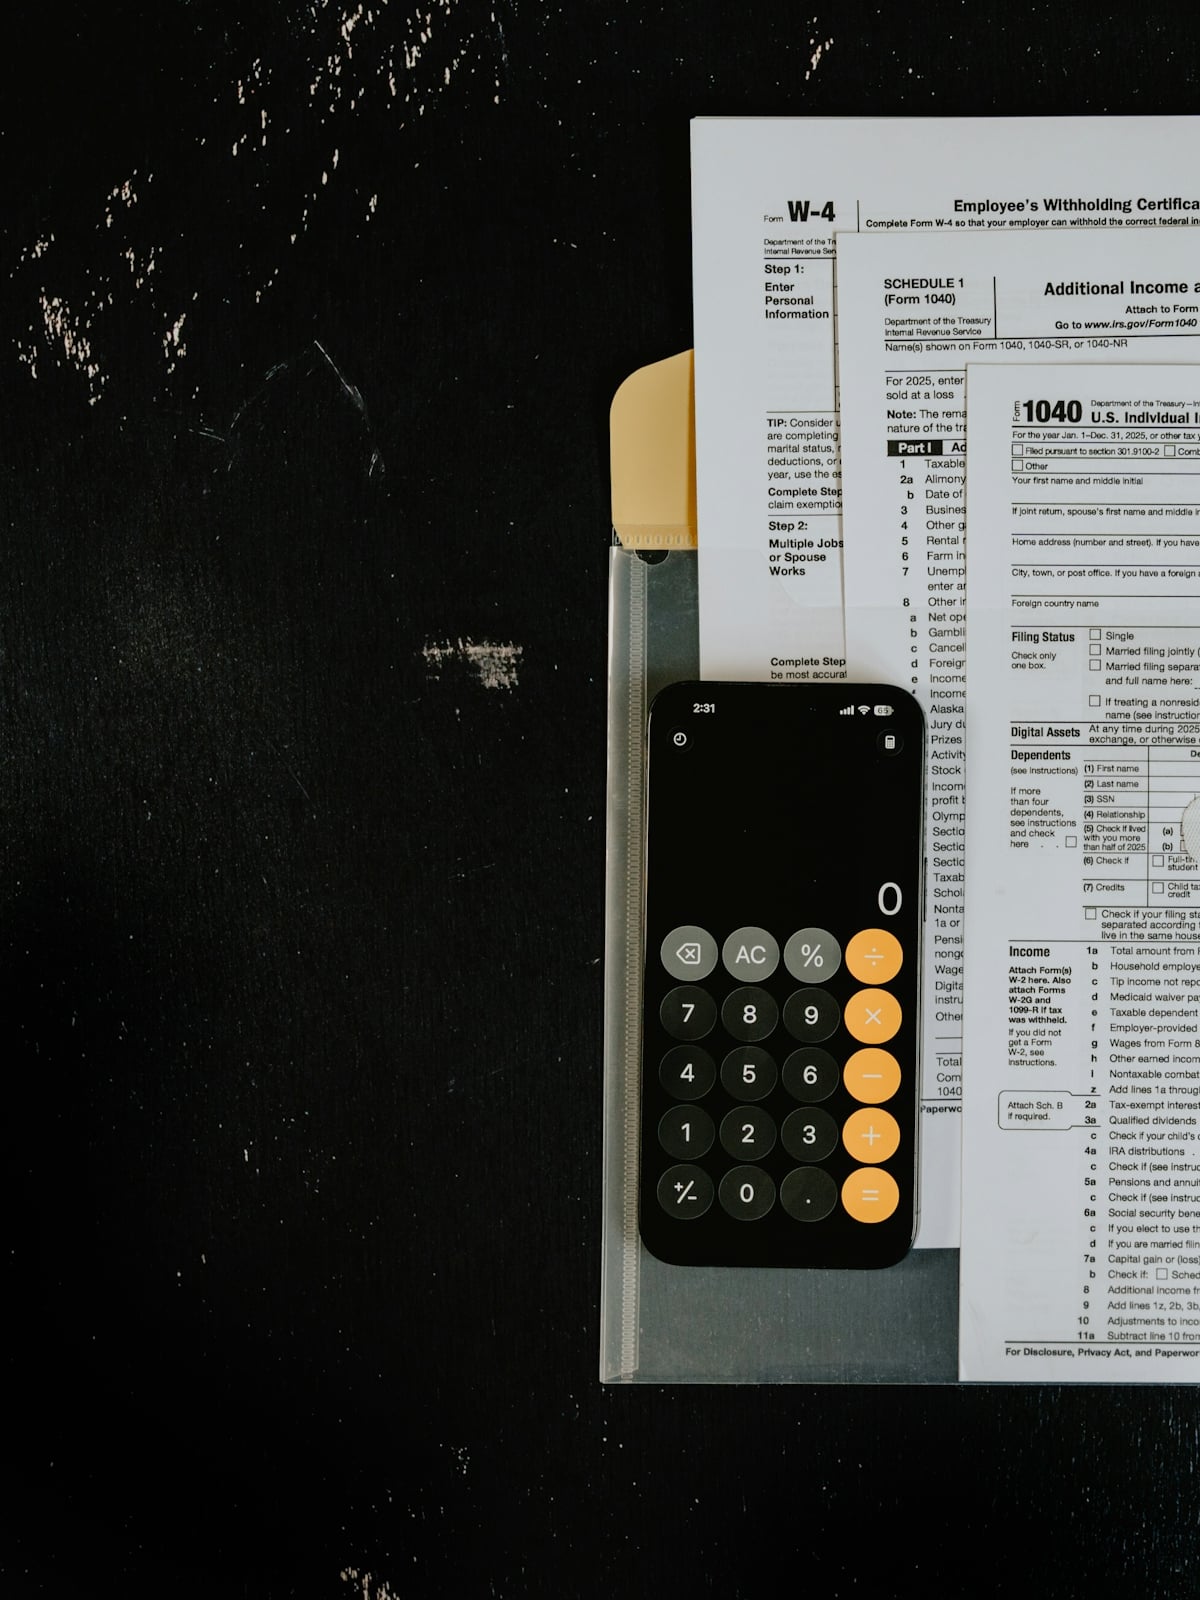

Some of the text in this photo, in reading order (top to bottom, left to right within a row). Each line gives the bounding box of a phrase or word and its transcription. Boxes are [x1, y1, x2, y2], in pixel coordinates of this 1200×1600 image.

[763, 200, 835, 223] Form W-4
[954, 198, 1038, 215] Employee's
[1043, 197, 1132, 213] Withholding
[764, 263, 804, 276] Step 1:
[764, 281, 794, 292] Enter
[884, 277, 954, 289] SCHEDULE
[1044, 280, 1124, 296] Additional
[1130, 280, 1188, 294] Income
[765, 295, 813, 305] Personal
[884, 292, 955, 306] (Form 1040)
[765, 308, 829, 319] Information
[1125, 304, 1157, 314] Attach
[1160, 305, 1170, 313] to
[1173, 304, 1198, 313] Form
[884, 316, 991, 327] Department of the Treasury
[1055, 320, 1069, 329] Go
[1071, 320, 1082, 329] to
[1084, 318, 1197, 330] www.irs.gov/Form1040
[885, 327, 981, 336] Internal Revenue Service
[1090, 399, 1131, 407] Department
[1013, 400, 1021, 421] Form
[1022, 399, 1082, 423] 1040
[766, 418, 833, 427] TIP: Consider
[1091, 411, 1119, 423] U.S.
[1124, 411, 1189, 423] Individual
[898, 442, 925, 454] Part
[924, 459, 965, 469] Taxable
[900, 474, 966, 485] 2a Alimony
[768, 520, 807, 532] Step 2:
[769, 538, 843, 550] Multiple Jobs
[769, 552, 826, 564] or Spouse
[769, 565, 805, 576] Works
[1011, 631, 1075, 644] Filing Status
[1105, 631, 1134, 642] Single
[693, 703, 715, 714] 2:31
[929, 704, 964, 713] Alaska
[1011, 726, 1080, 739] Digital Assets
[1011, 749, 1070, 762] Dependents
[877, 882, 903, 916] 0
[735, 945, 766, 965] AC
[1009, 945, 1050, 957] Income
[1086, 946, 1098, 954] 1a
[1110, 946, 1133, 955] Total
[1135, 946, 1171, 955] amount
[1173, 946, 1194, 955] from
[682, 1004, 818, 1024] 7 8 9
[680, 1064, 817, 1084] 4 5 6
[741, 1124, 755, 1142] 2
[803, 1125, 817, 1144] 3
[740, 1184, 754, 1202] 0
